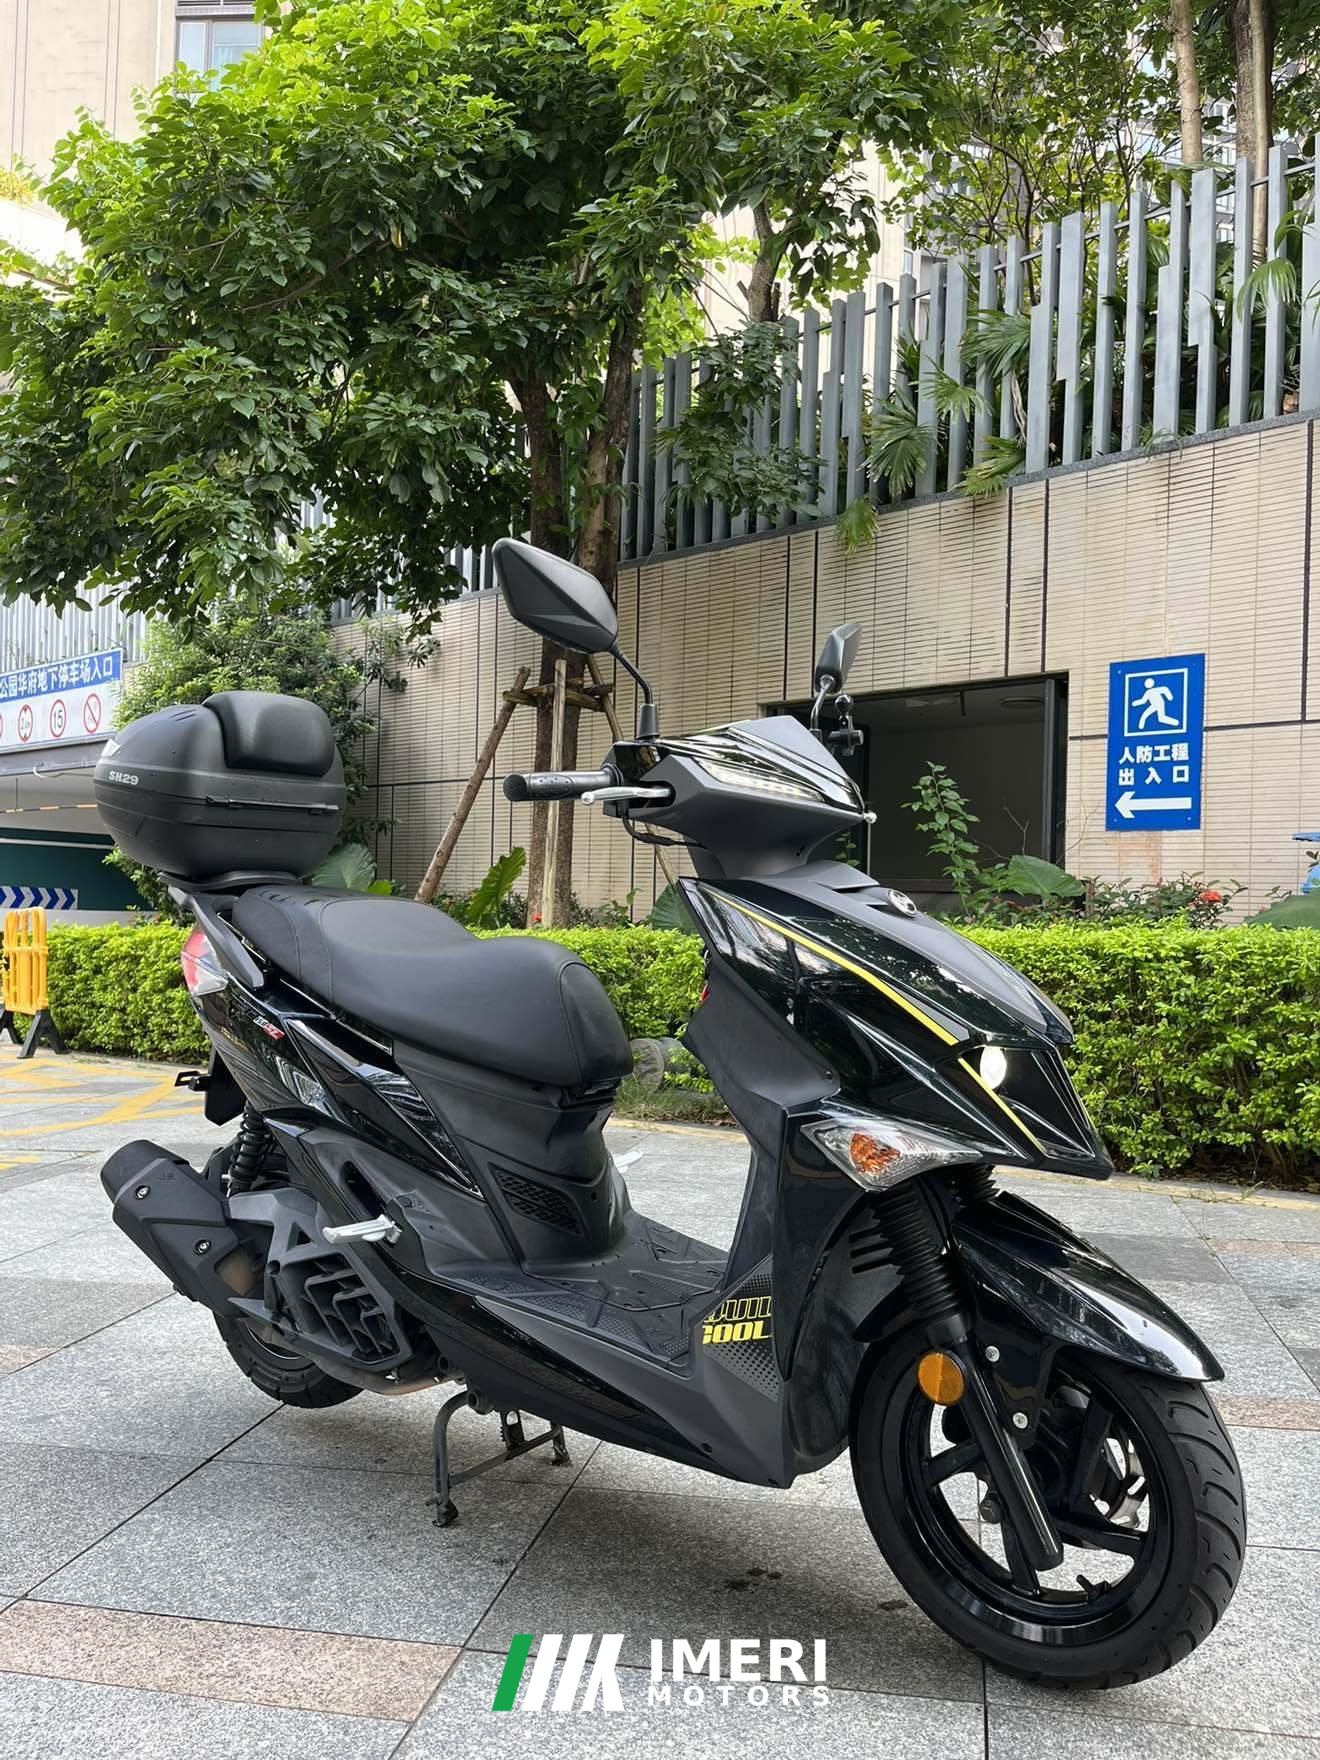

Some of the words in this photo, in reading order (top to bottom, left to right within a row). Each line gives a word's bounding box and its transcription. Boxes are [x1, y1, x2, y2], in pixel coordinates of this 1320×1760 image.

[0, 655, 113, 698] 公园华府地下停车场入口
[53, 709, 64, 729] 15
[1118, 742, 1190, 765] 人防工程
[108, 770, 139, 786] SH29
[1118, 765, 1190, 786] 出入口
